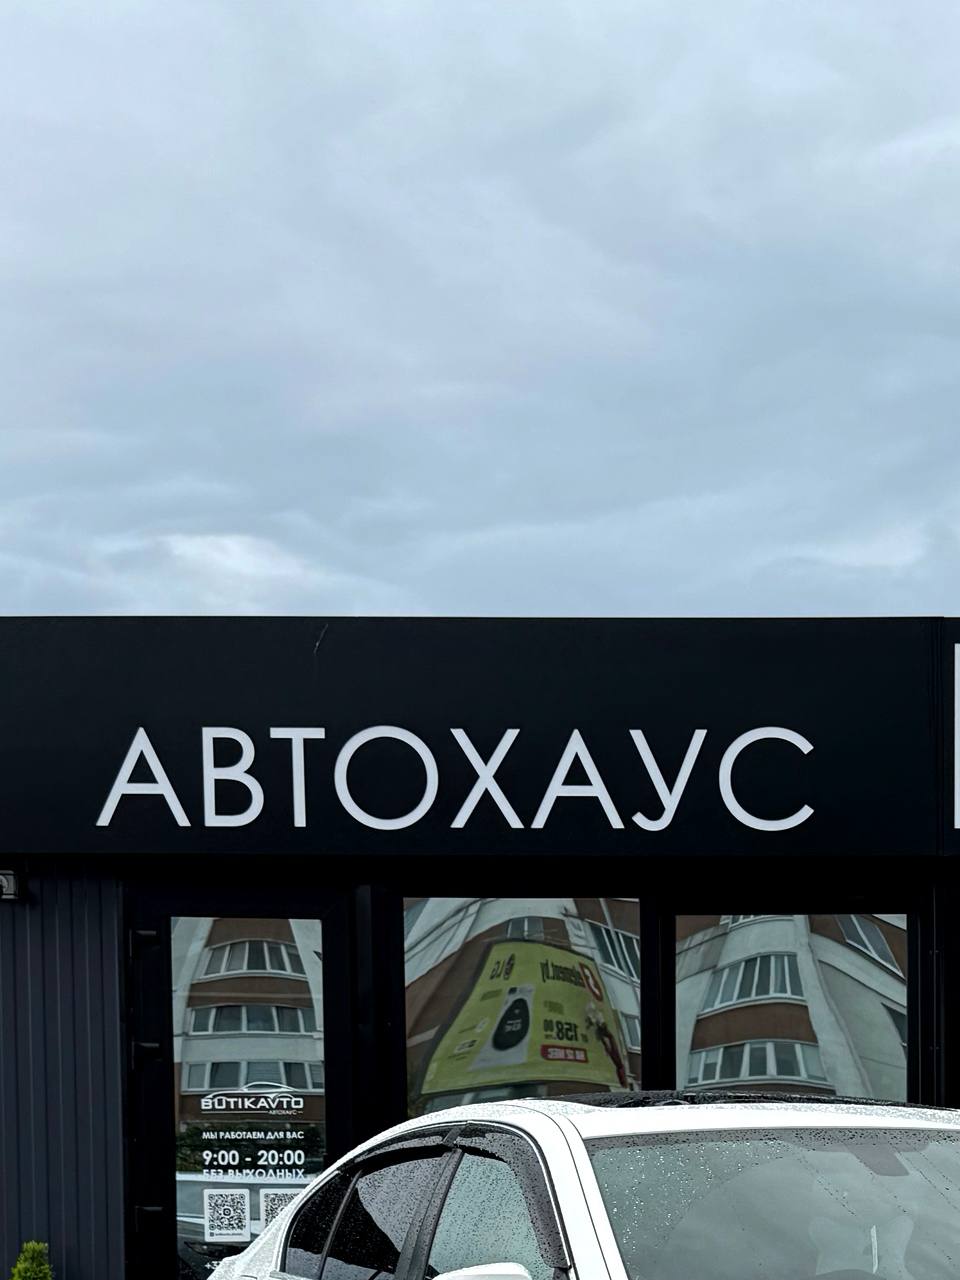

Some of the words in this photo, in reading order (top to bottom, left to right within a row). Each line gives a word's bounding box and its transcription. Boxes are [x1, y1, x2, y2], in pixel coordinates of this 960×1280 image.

[95, 724, 815, 832] АВТОХАУС
[201, 1097, 304, 1110] BUTIKAVTO
[219, 1131, 265, 1139] РАБОТАЕМ
[266, 1131, 284, 1140] ДЛЯ
[286, 1131, 305, 1139] ВАС
[202, 1150, 239, 1165] 9:00
[257, 1150, 305, 1165] 20:00
